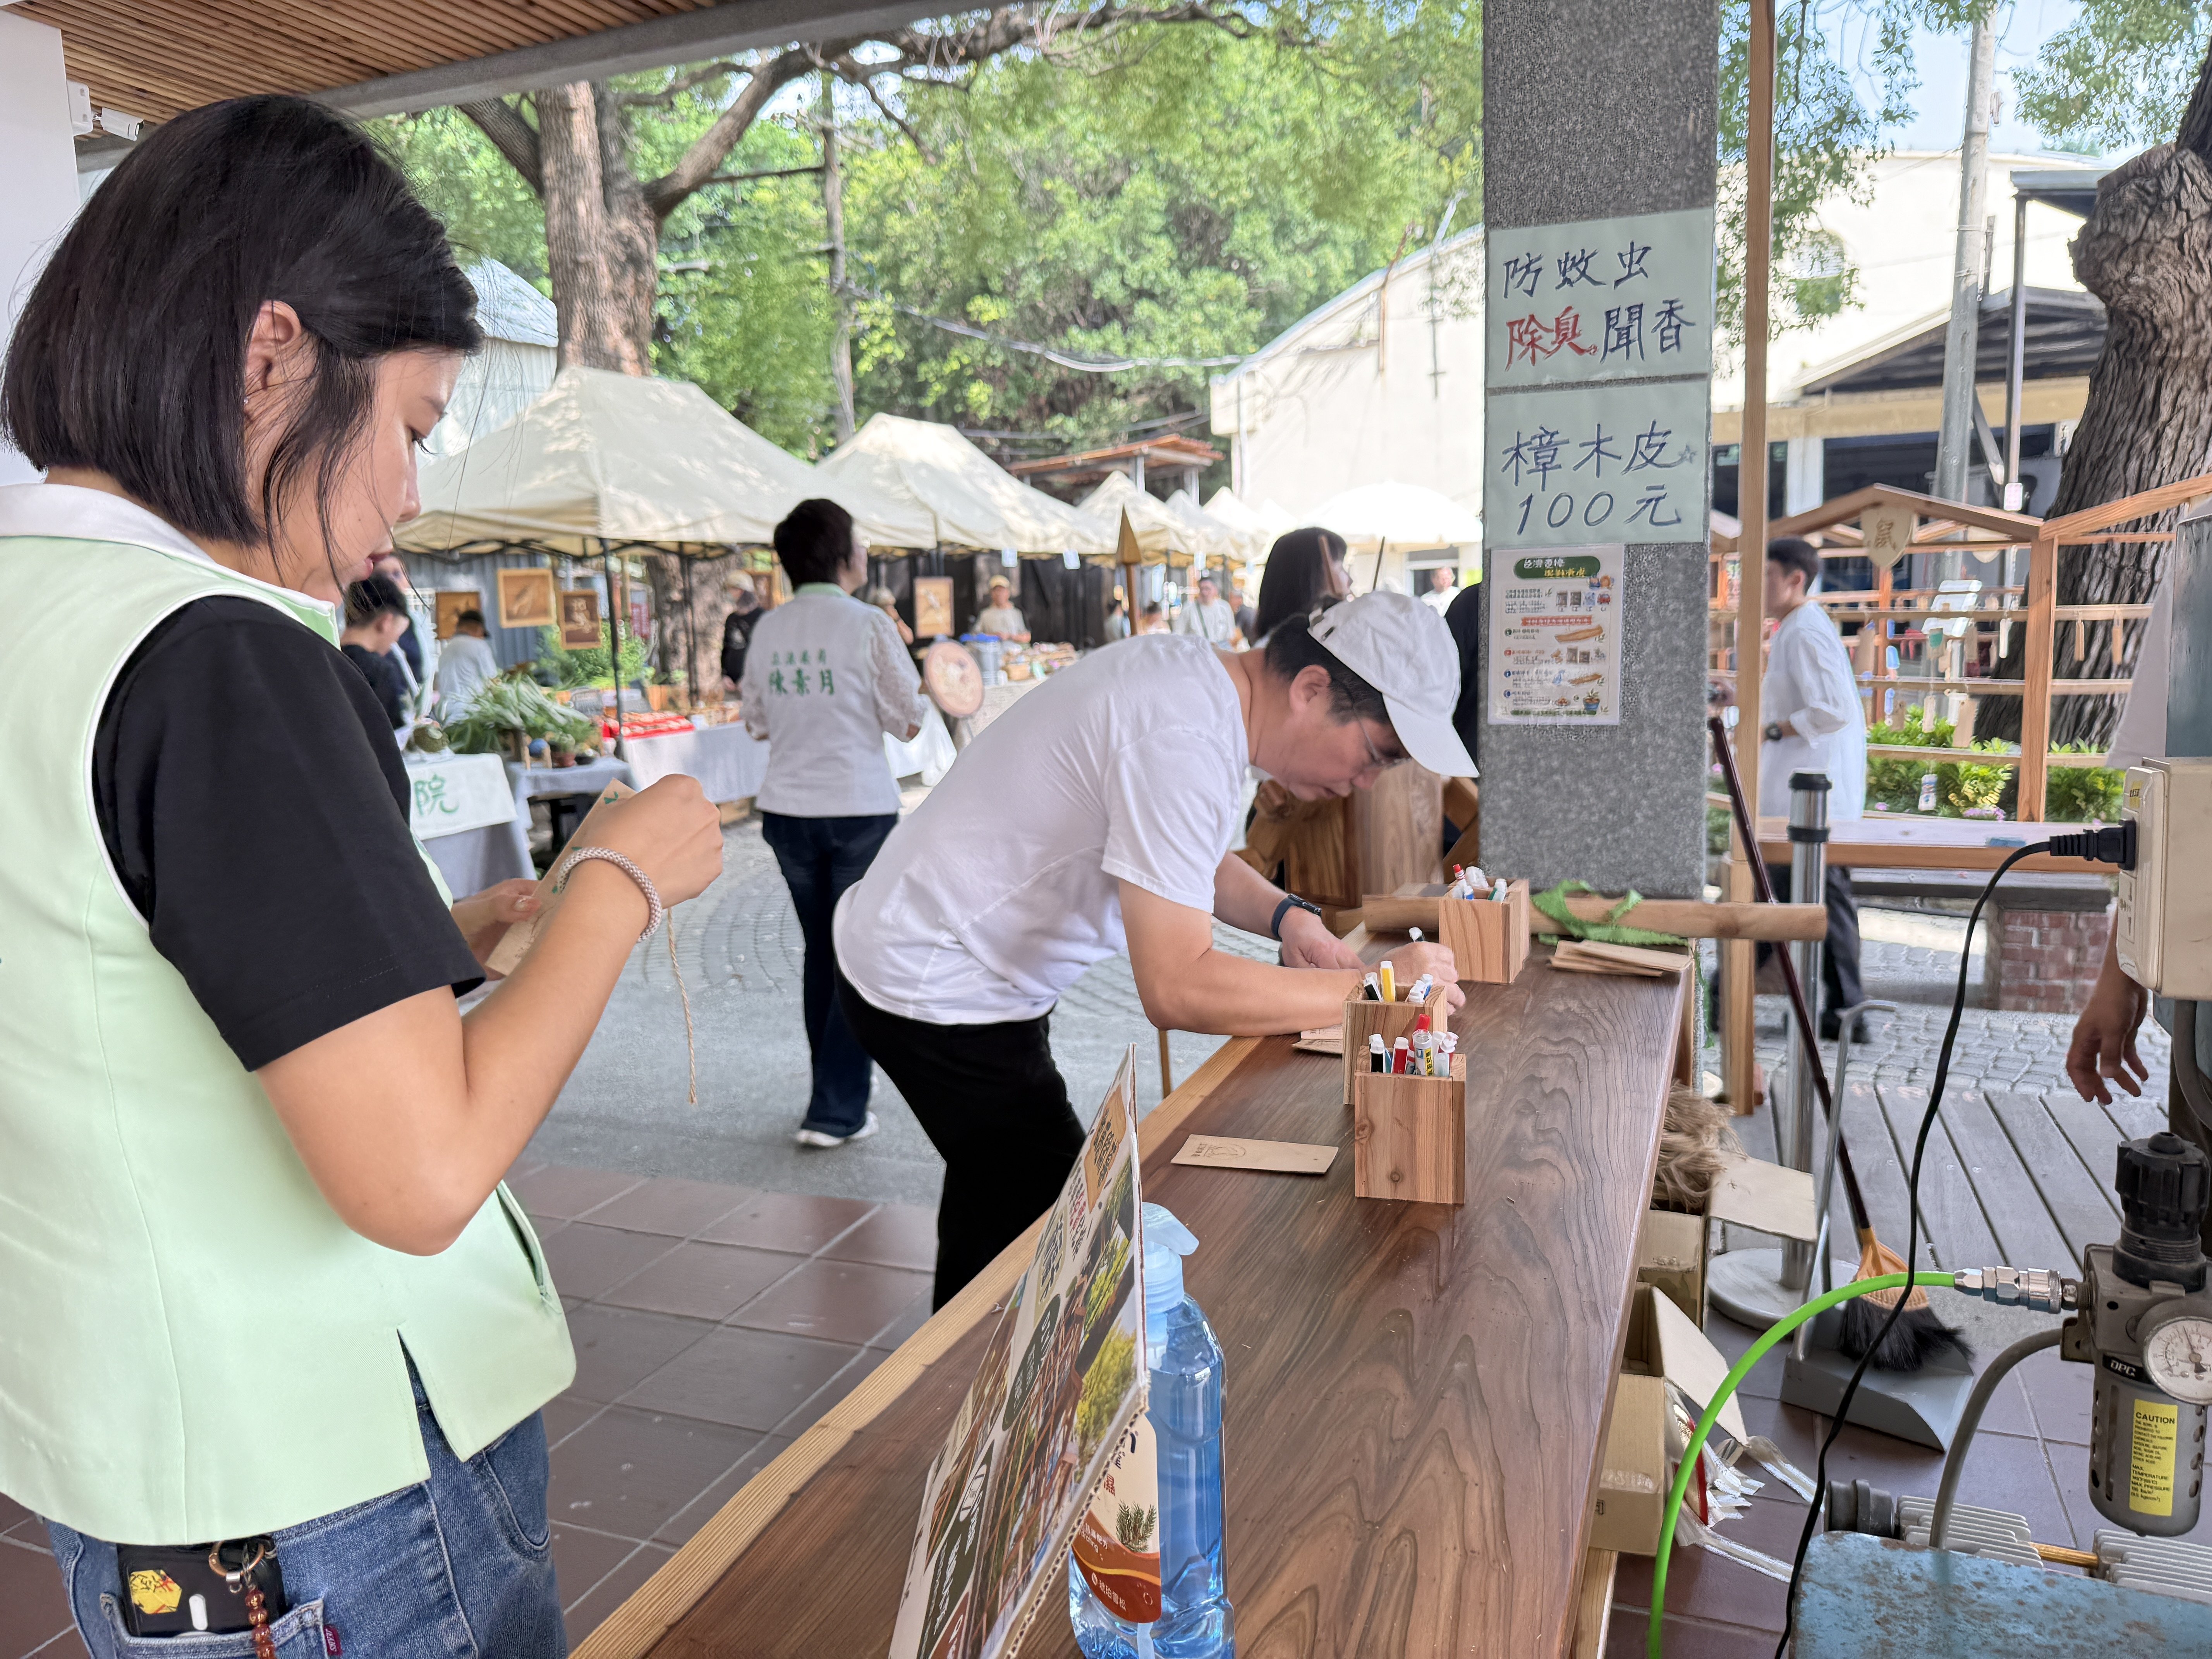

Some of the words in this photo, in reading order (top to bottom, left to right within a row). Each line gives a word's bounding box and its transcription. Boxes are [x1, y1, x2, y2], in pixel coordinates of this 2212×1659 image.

[1503, 240, 1652, 299] 防蚊虫
[1505, 298, 1695, 372] 除臭聞香
[1501, 419, 1681, 491] 樟木皮
[1517, 484, 1681, 535] 100元
[414, 772, 460, 816] 院
[2136, 1412, 2175, 1424] CAUTION
